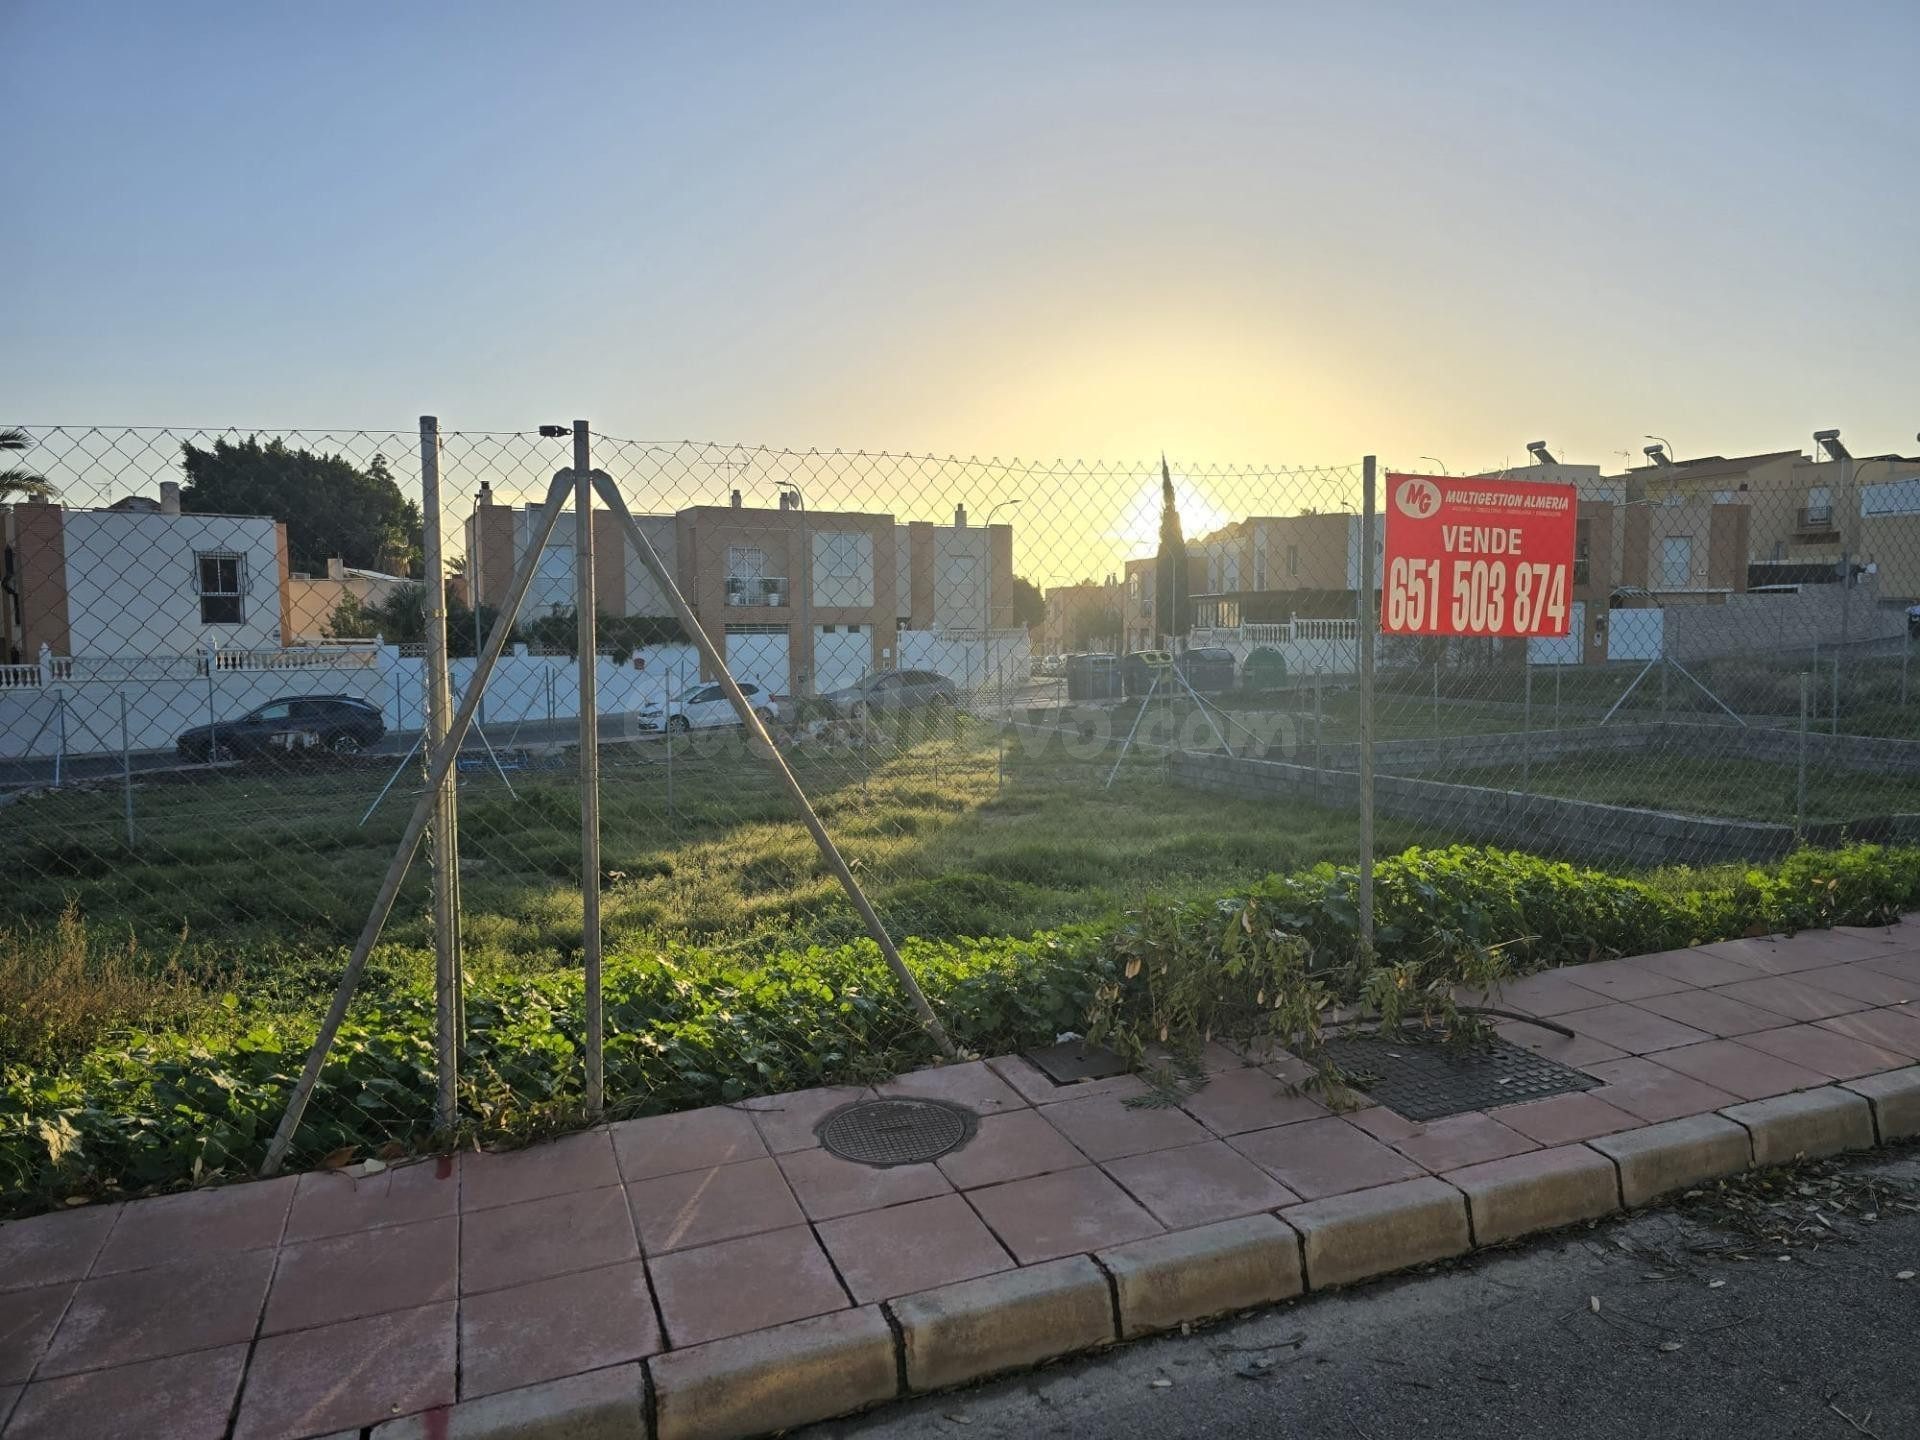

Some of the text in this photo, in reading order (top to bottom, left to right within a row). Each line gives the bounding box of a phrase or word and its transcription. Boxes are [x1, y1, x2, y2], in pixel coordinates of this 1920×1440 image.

[1405, 483, 1432, 514] MG
[1445, 490, 1569, 510] MULTIGESTION ALMERIA
[1442, 525, 1522, 554] VENDE
[1388, 556, 1566, 633] 651 503 874
